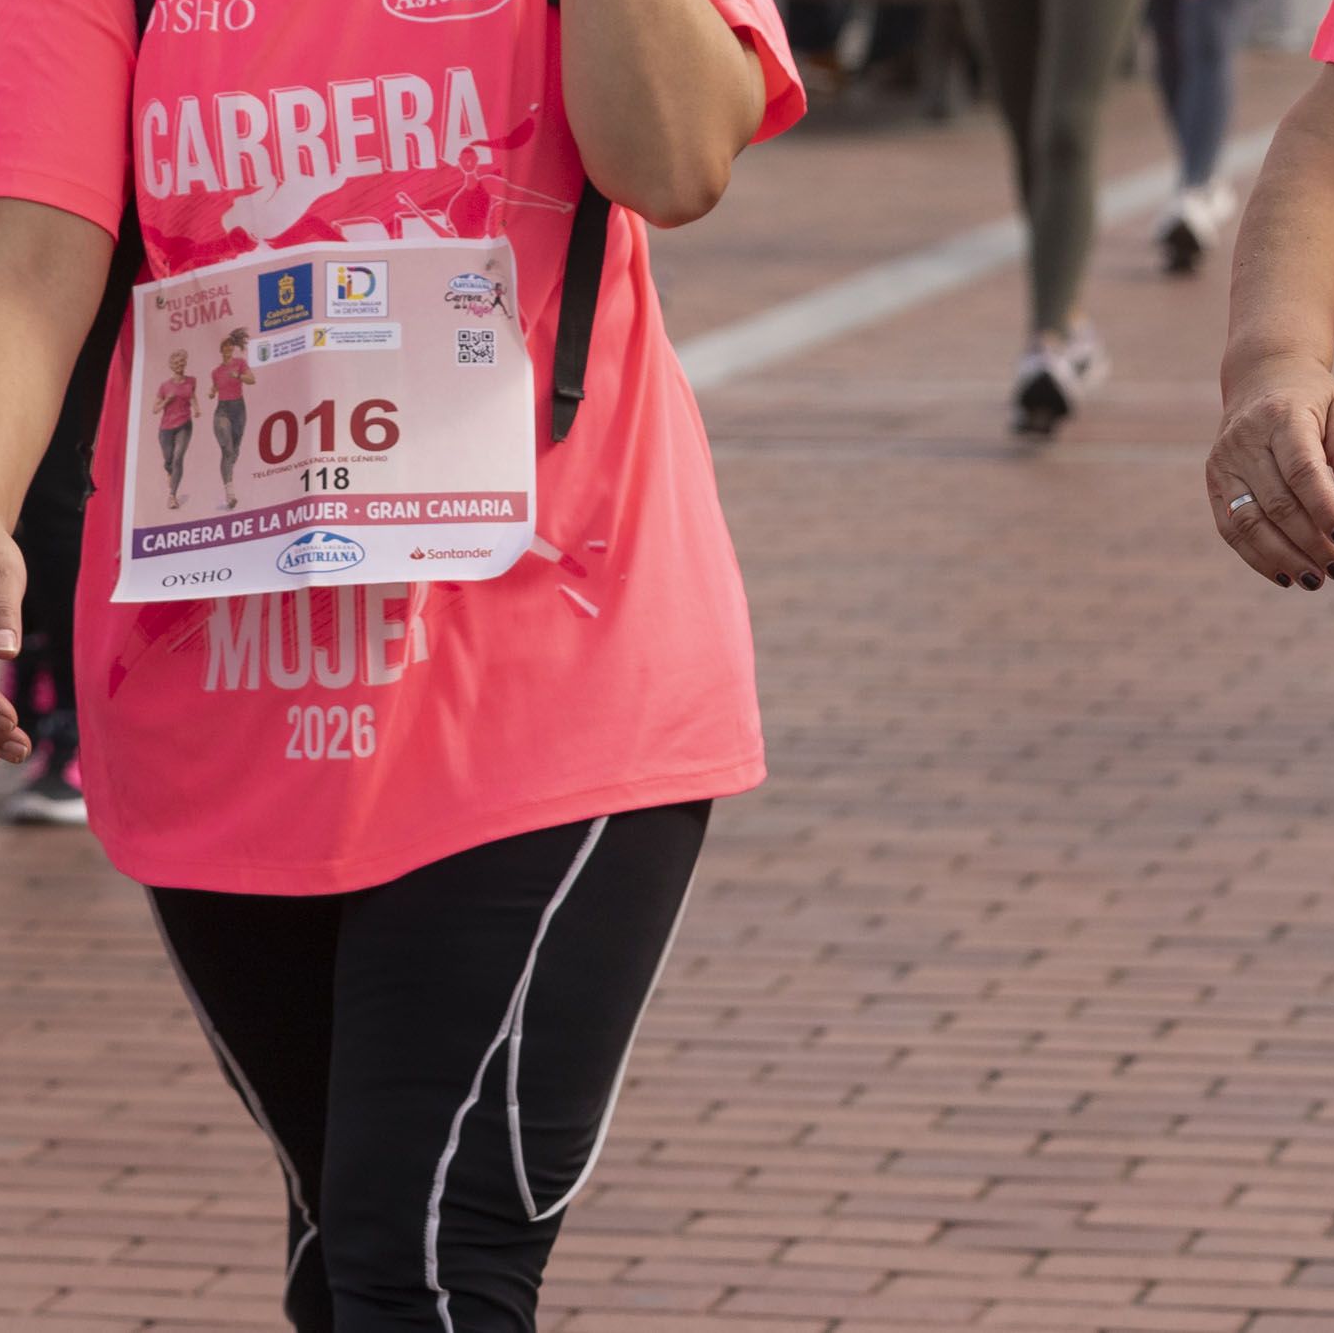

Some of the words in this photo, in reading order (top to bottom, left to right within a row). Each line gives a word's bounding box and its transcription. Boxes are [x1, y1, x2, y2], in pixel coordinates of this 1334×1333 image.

[141, 66, 493, 199] CARRERA
[166, 297, 183, 312] TU
[185, 284, 233, 307] DORSAL
[169, 297, 234, 332] SUMA
[258, 398, 400, 464] 016
[337, 455, 349, 463] DE
[299, 467, 350, 492] 118
[142, 525, 225, 553] CARRERA
[231, 519, 254, 539] DE
[259, 513, 281, 533] LA
[286, 501, 348, 527] MUJER
[367, 501, 420, 519] GRAN
[426, 499, 513, 519] CANARIA
[283, 550, 358, 569] ASTURIANA
[427, 547, 493, 560] Santander
[162, 568, 232, 588] OYSHO
[285, 704, 377, 761] 2026
